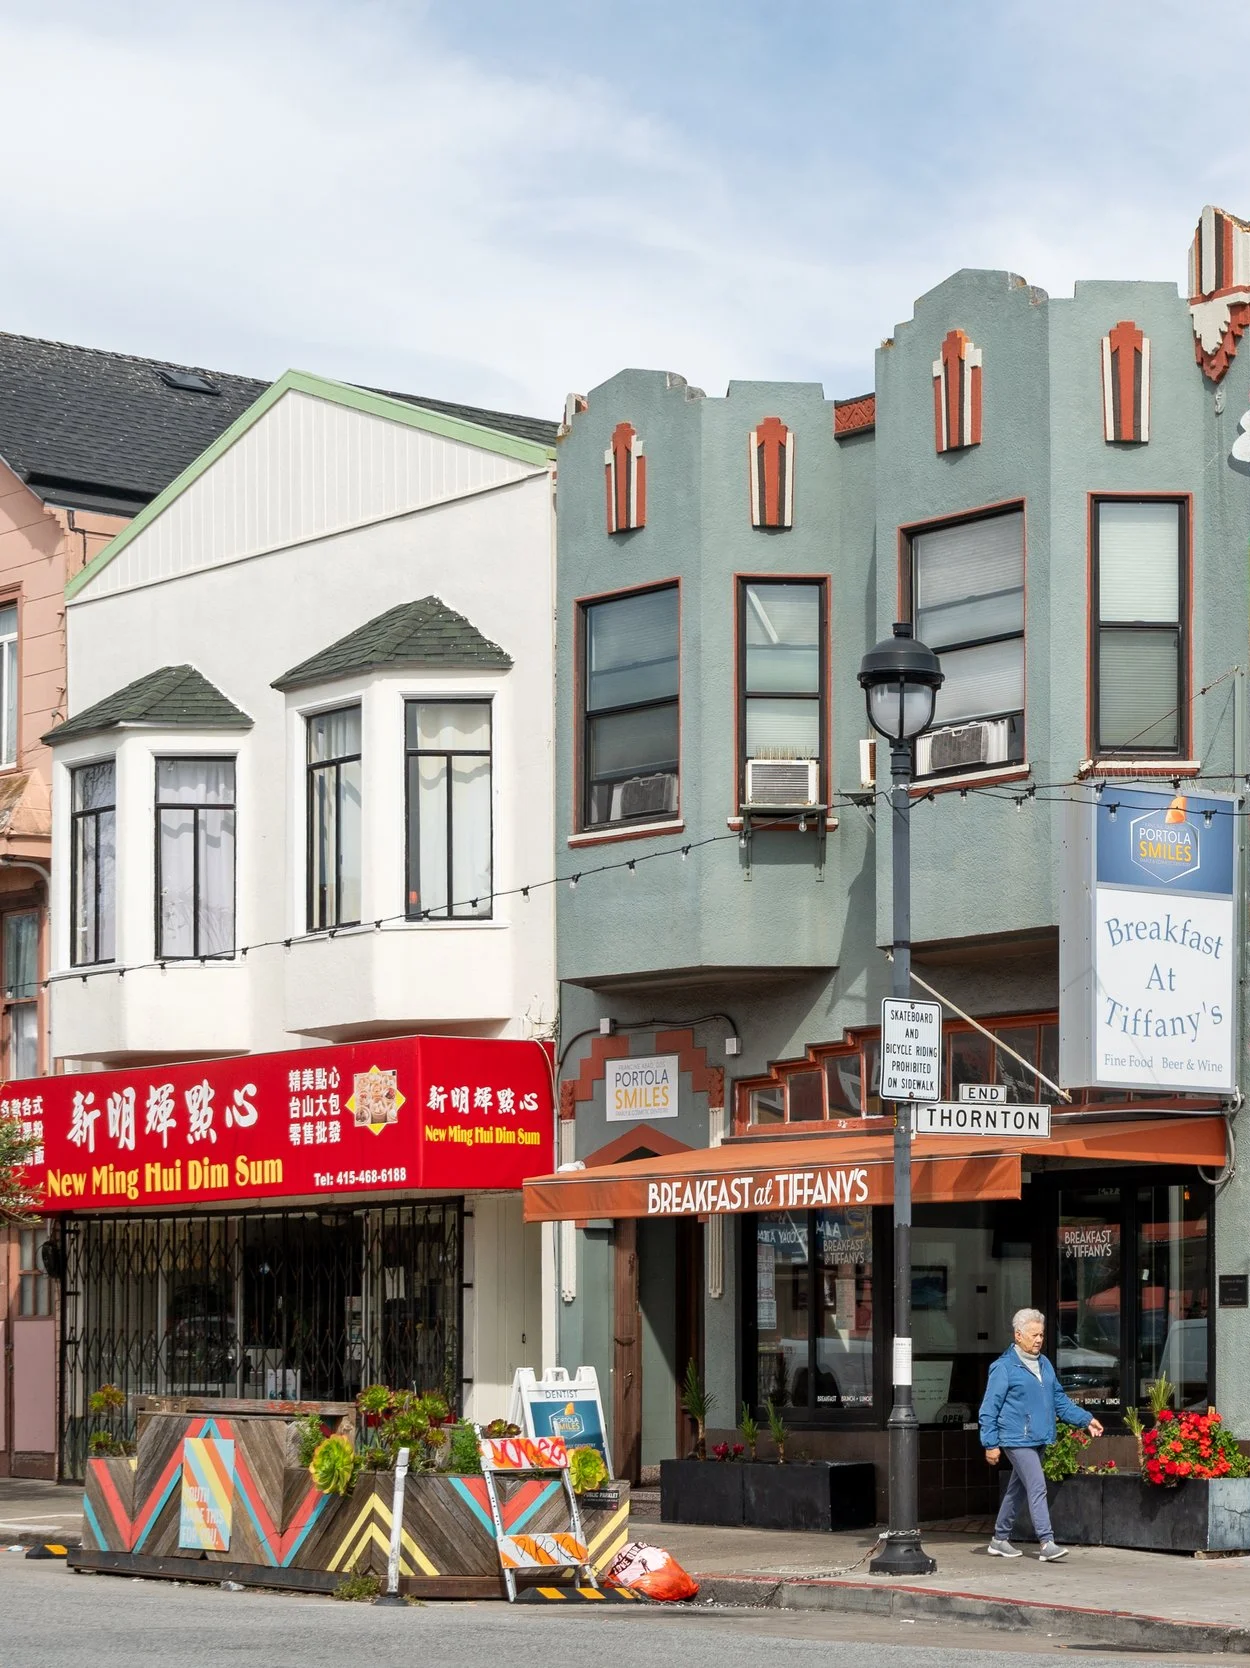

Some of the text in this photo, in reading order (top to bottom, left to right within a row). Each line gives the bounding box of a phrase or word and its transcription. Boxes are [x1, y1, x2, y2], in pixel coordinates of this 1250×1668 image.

[1139, 827, 1192, 845] PORTOLA
[1139, 841, 1192, 863] SMILES
[1104, 914, 1224, 959] Breakfast
[1145, 963, 1176, 992] At
[890, 1009, 933, 1024] SKATEBOARD
[1104, 996, 1223, 1043] Tiffany's
[904, 1028, 919, 1039] AND
[886, 1043, 938, 1058] BICYCLE RIDING
[891, 1060, 932, 1074] PROHIBITED
[1104, 1053, 1223, 1073] Fine Food Beer & Wine
[288, 1066, 341, 1092] 精美點心
[615, 1069, 669, 1088] PORTOLA
[887, 1077, 935, 1091] ON SIDEWALK
[615, 1085, 669, 1110] SMILES
[968, 1087, 999, 1100] END
[289, 1093, 341, 1119] 台山大包
[926, 1108, 1040, 1130] THORNTON
[289, 1120, 341, 1146] 零售批發
[425, 1125, 541, 1147] New Ming Hui Dim Sum
[48, 1155, 283, 1200] New Ming Hui Dim Sum
[314, 1167, 407, 1187] Tel: 415-468-6188
[647, 1168, 869, 1214] BREAKFAST at TIFFANY'S
[823, 1239, 865, 1252] BREAKFAST
[1064, 1229, 1112, 1244] BREAKFAST
[830, 1251, 865, 1265] TIFFANY'S
[1072, 1242, 1112, 1258] TIFFANY'S
[545, 1389, 578, 1399] DENTIST
[558, 1422, 581, 1431] MILES
[942, 1414, 963, 1424] OPEN
[184, 1486, 210, 1502] YOUTH
[181, 1525, 199, 1544] FOR
